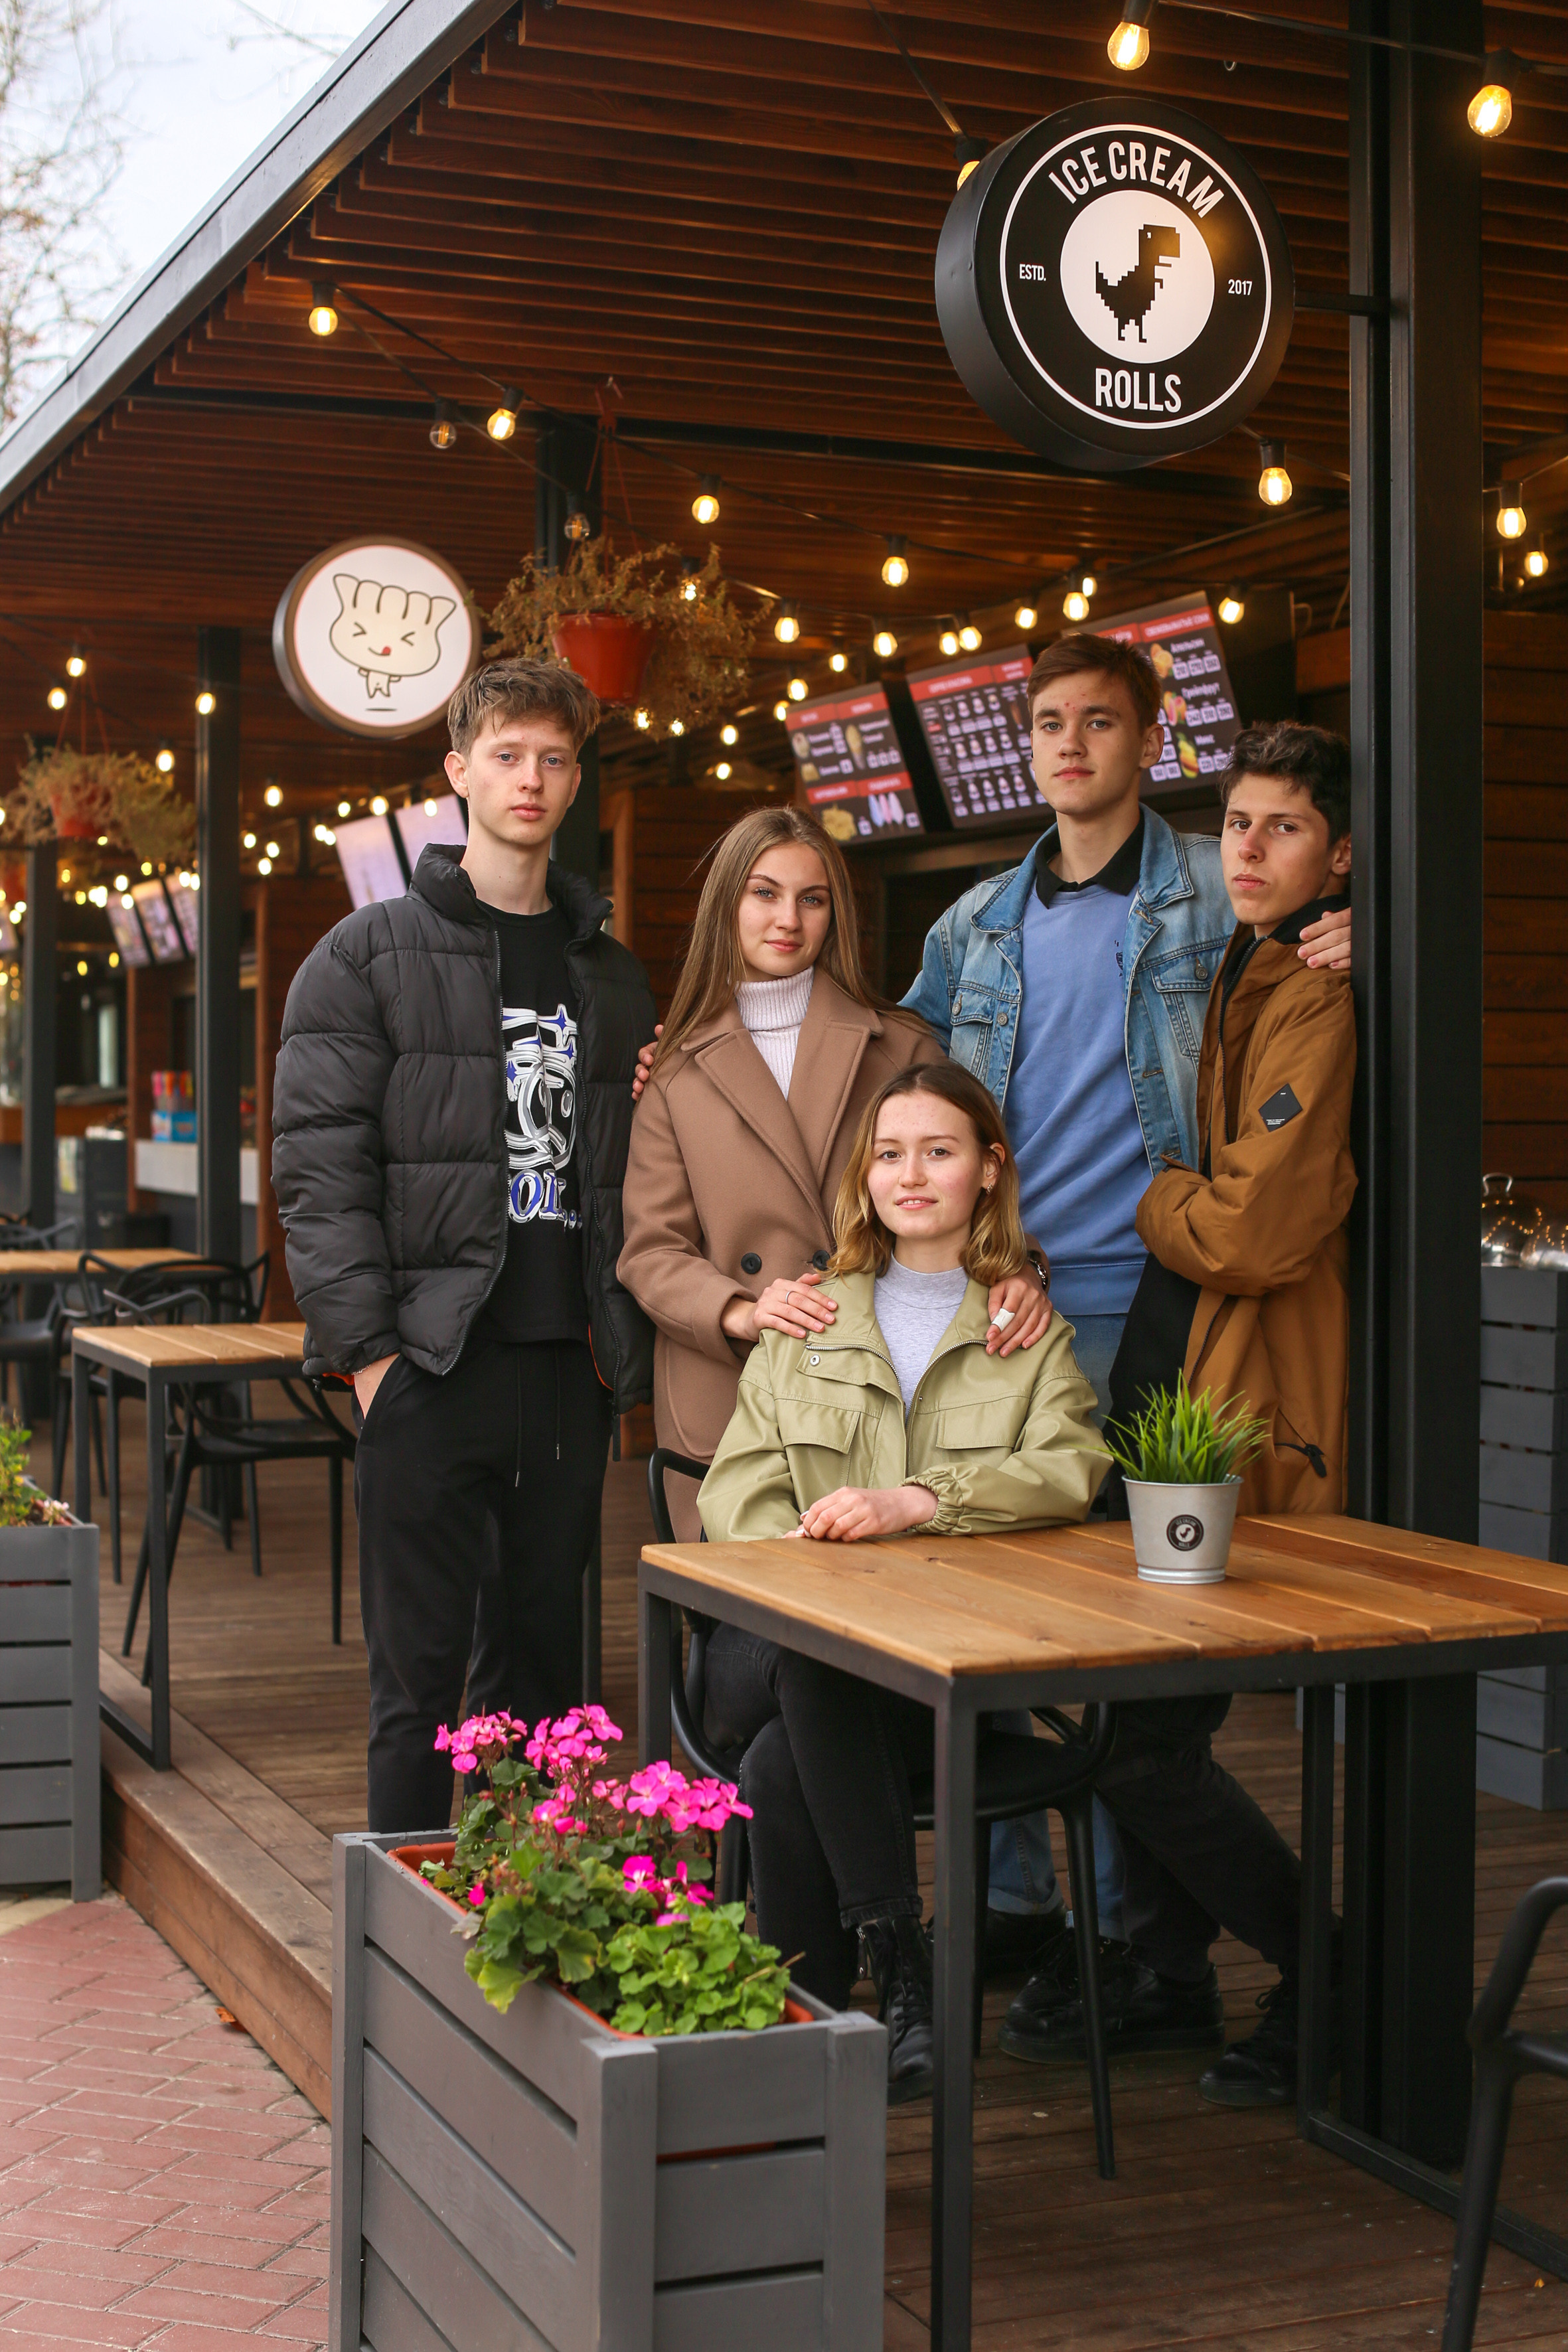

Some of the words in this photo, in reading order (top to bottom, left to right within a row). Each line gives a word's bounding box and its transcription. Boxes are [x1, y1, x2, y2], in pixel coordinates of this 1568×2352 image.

[1049, 147, 1107, 204] ICE
[1108, 141, 1225, 218] CREAM
[1018, 263, 1047, 281] ESTD.
[1227, 279, 1253, 296] 2017
[1095, 367, 1182, 413] ROLLS
